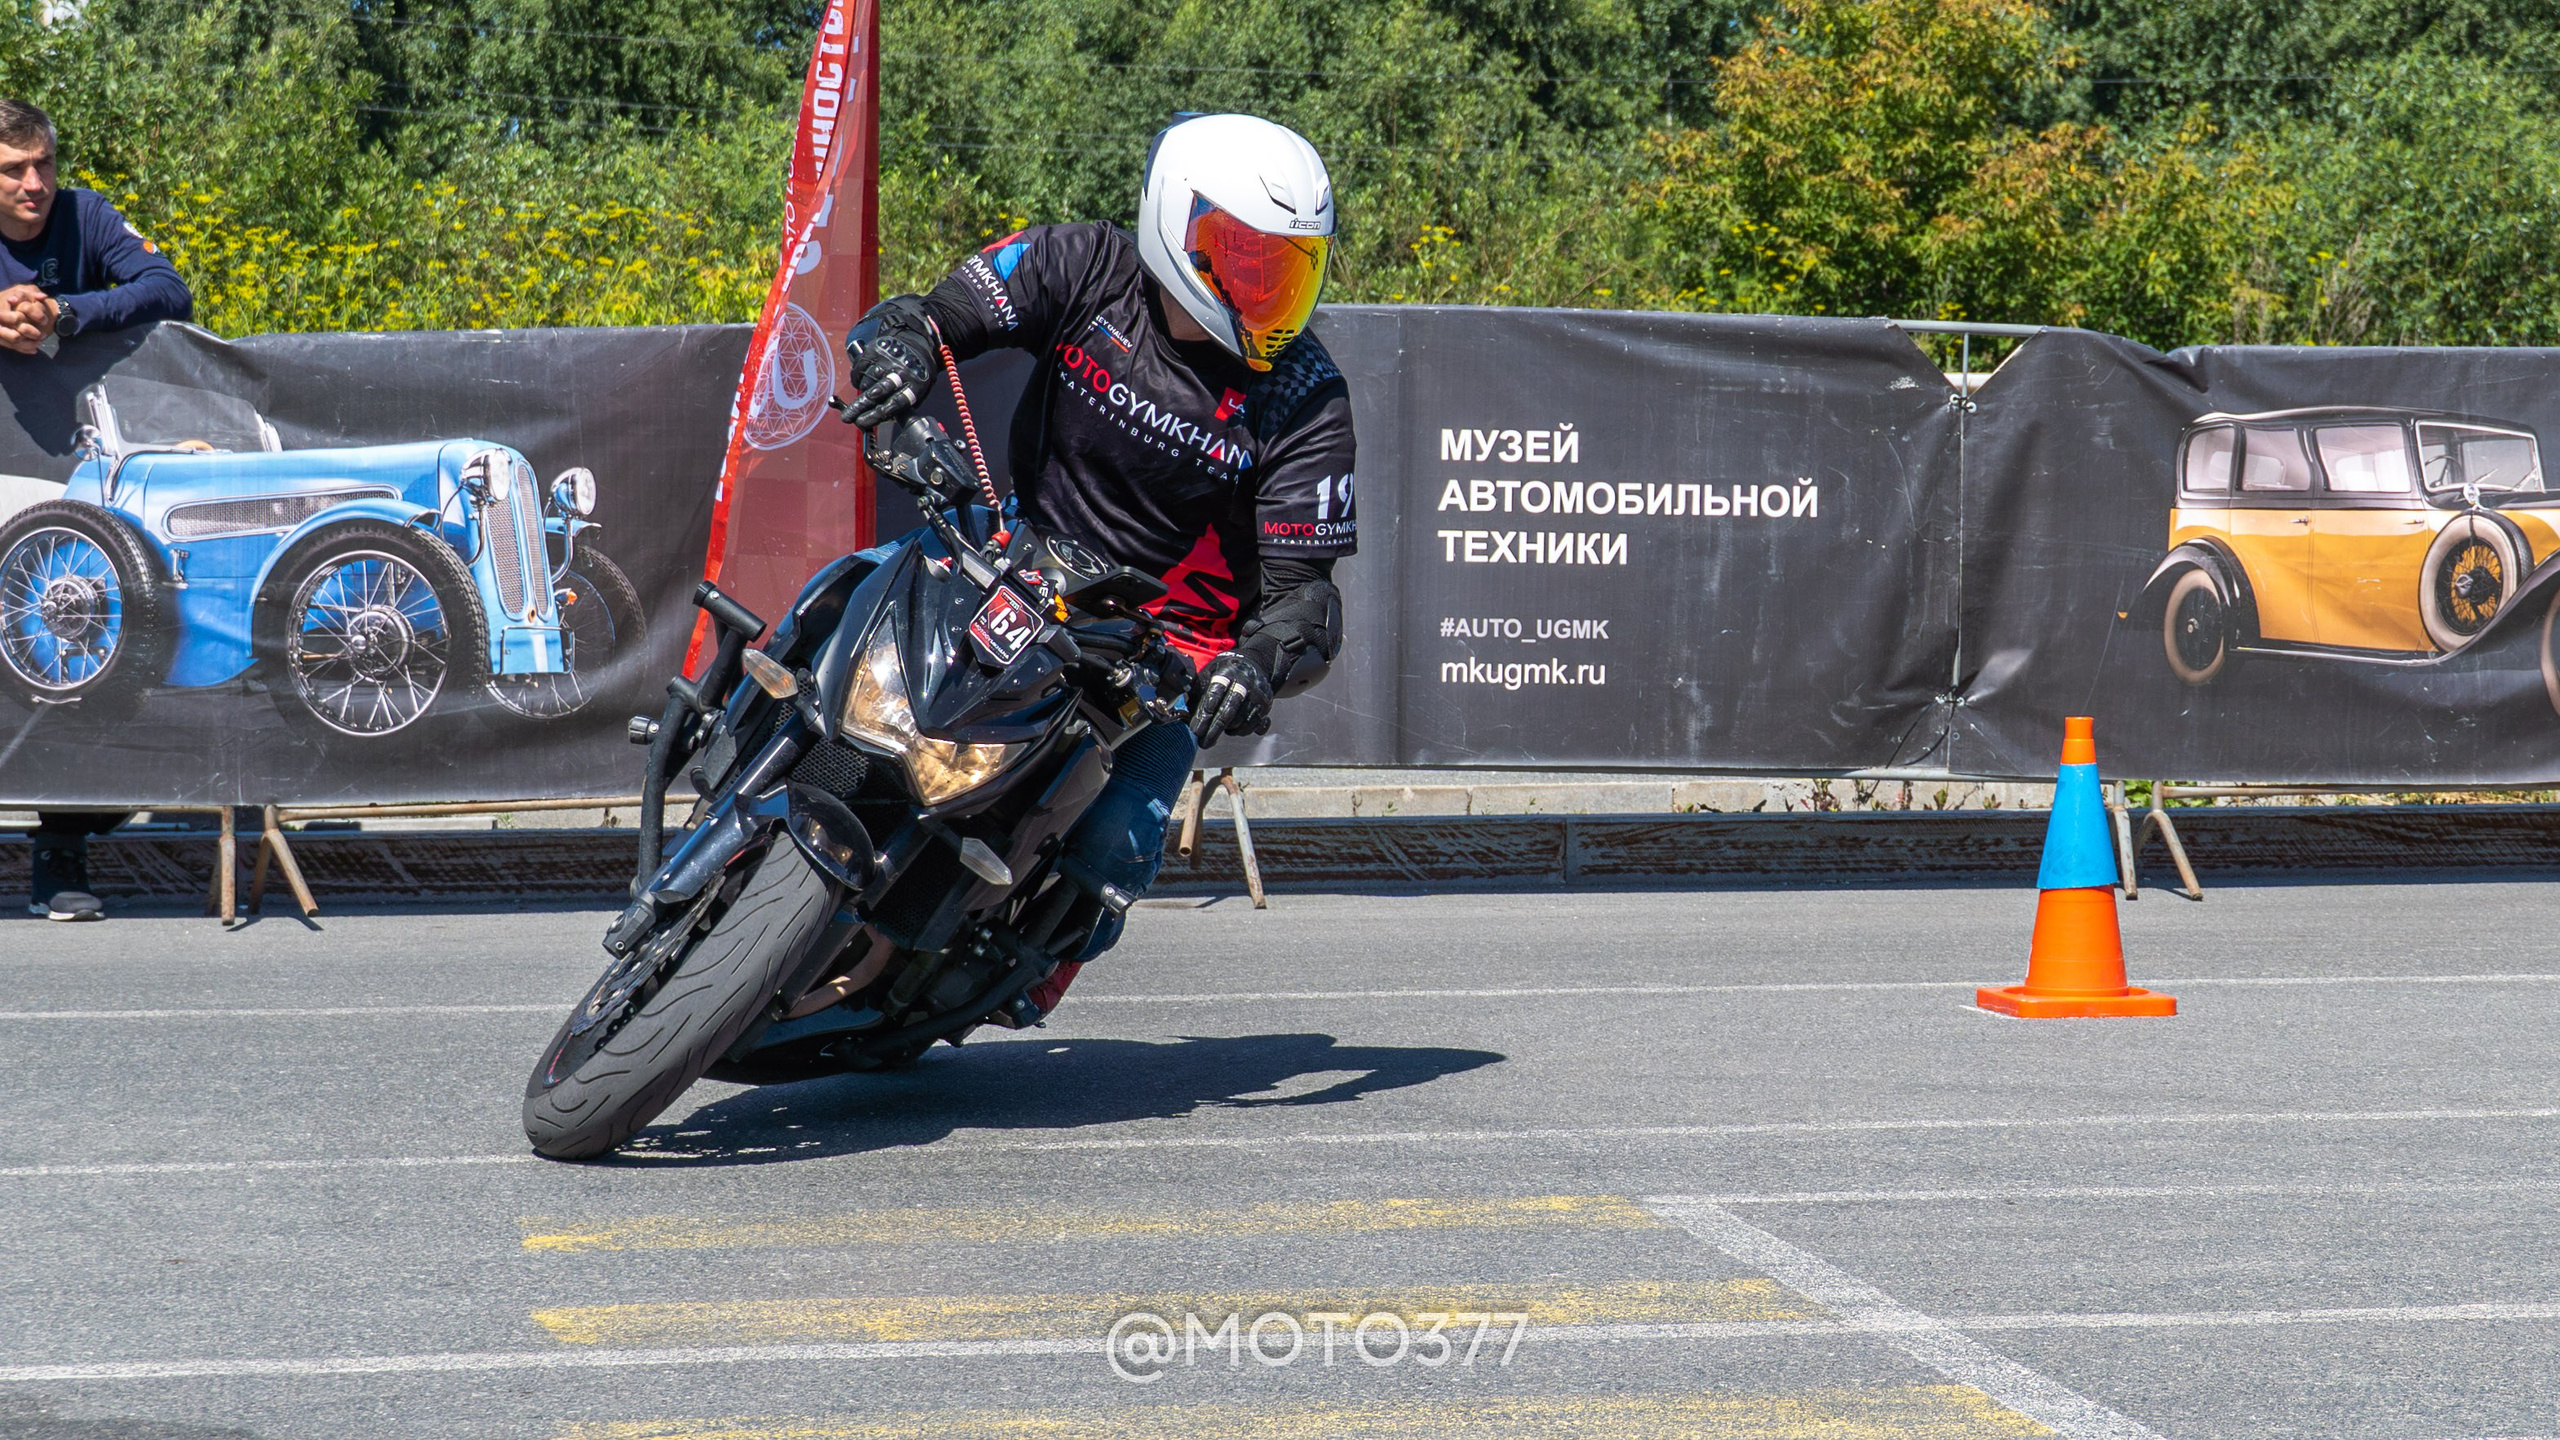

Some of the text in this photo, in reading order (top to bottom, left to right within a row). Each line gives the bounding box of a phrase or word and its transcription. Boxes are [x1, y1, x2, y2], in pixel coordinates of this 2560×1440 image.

[1440, 422, 1580, 464] МУЗЕЙ
[1437, 476, 1819, 519] АВТОМОБИЛЬНОЙ
[1437, 530, 1629, 566] ТЕХНИКИ
[990, 607, 1032, 651] 64
[1440, 617, 1610, 643] #AUTO_UGMK
[1440, 656, 1607, 690] mkugmk.ru
